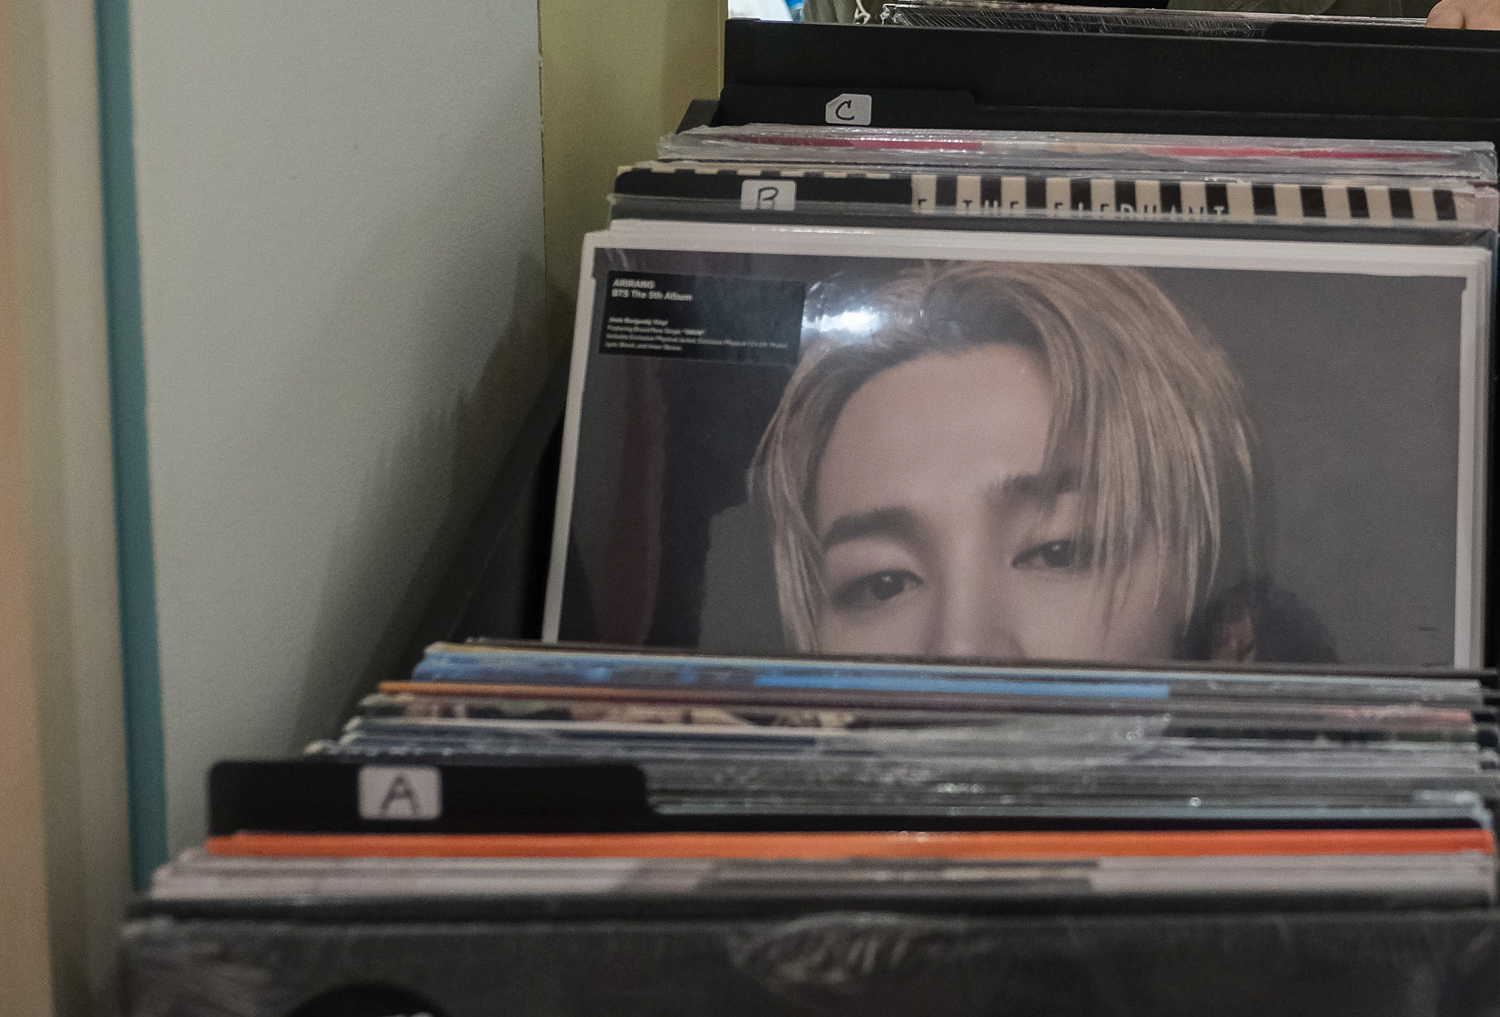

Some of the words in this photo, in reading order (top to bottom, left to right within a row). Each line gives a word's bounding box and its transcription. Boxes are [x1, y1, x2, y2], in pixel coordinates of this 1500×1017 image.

[835, 99, 855, 121] C
[612, 278, 656, 290] ARIRANG
[611, 288, 630, 298] BTS
[631, 289, 647, 299] The
[648, 290, 663, 300] 5th
[664, 290, 693, 301] Album
[380, 775, 421, 817] A
